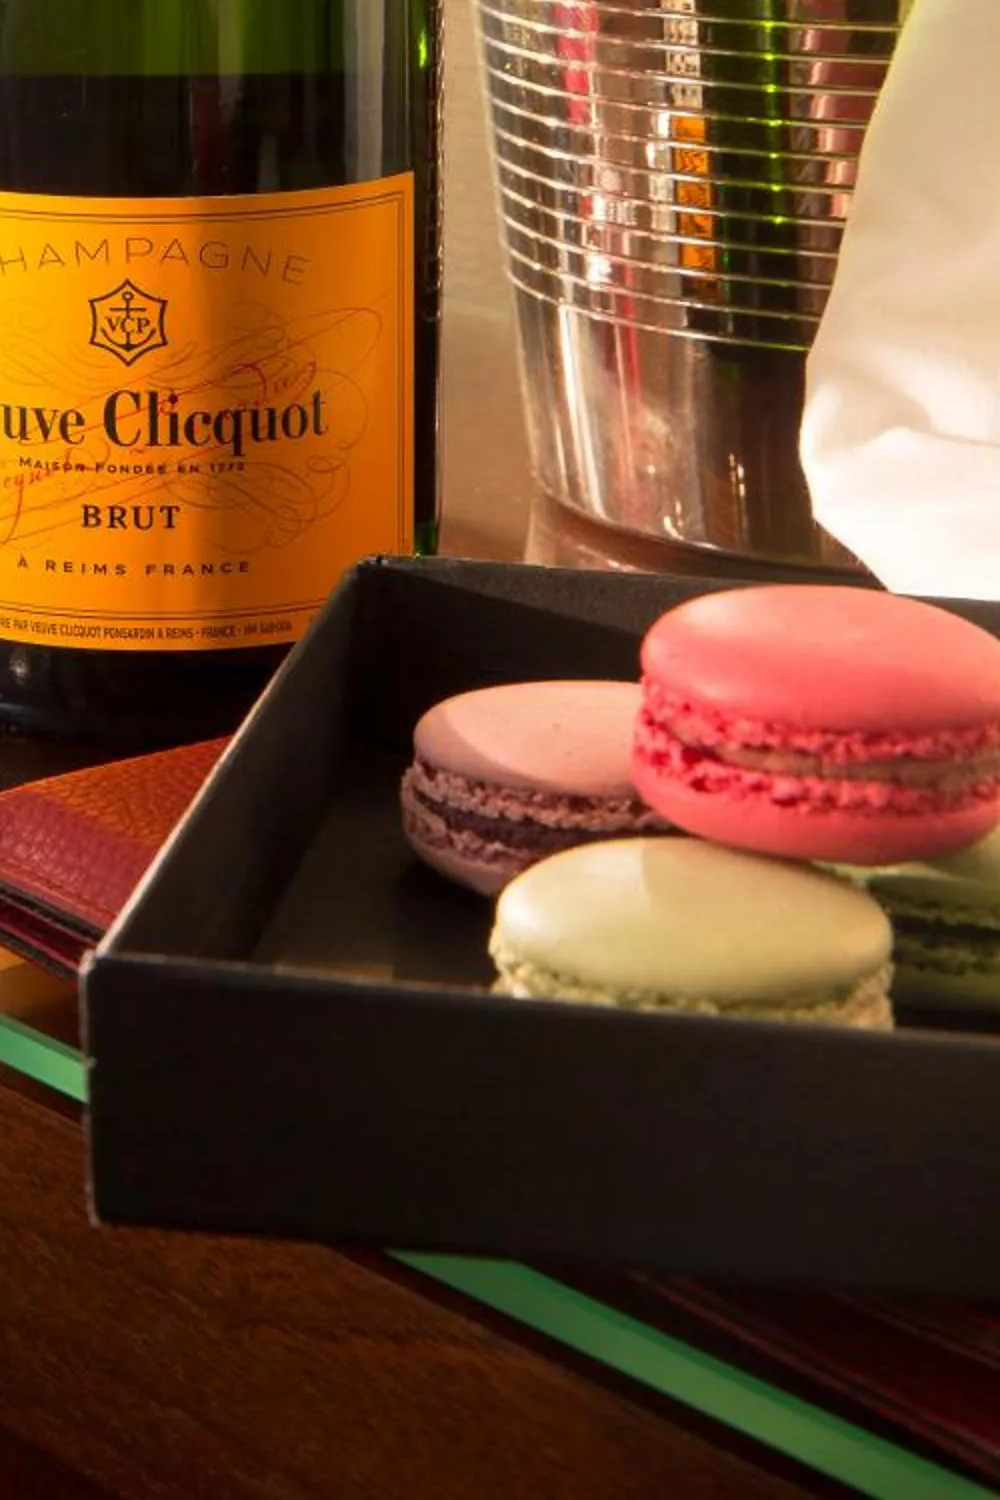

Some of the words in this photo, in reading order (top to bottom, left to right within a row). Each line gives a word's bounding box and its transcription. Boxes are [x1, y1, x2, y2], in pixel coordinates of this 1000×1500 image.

[105, 315, 150, 334] VCP
[102, 387, 329, 457] Clicquot
[81, 503, 181, 530] BRUT
[45, 559, 127, 576] REIMS
[145, 560, 250, 576] FRANCE
